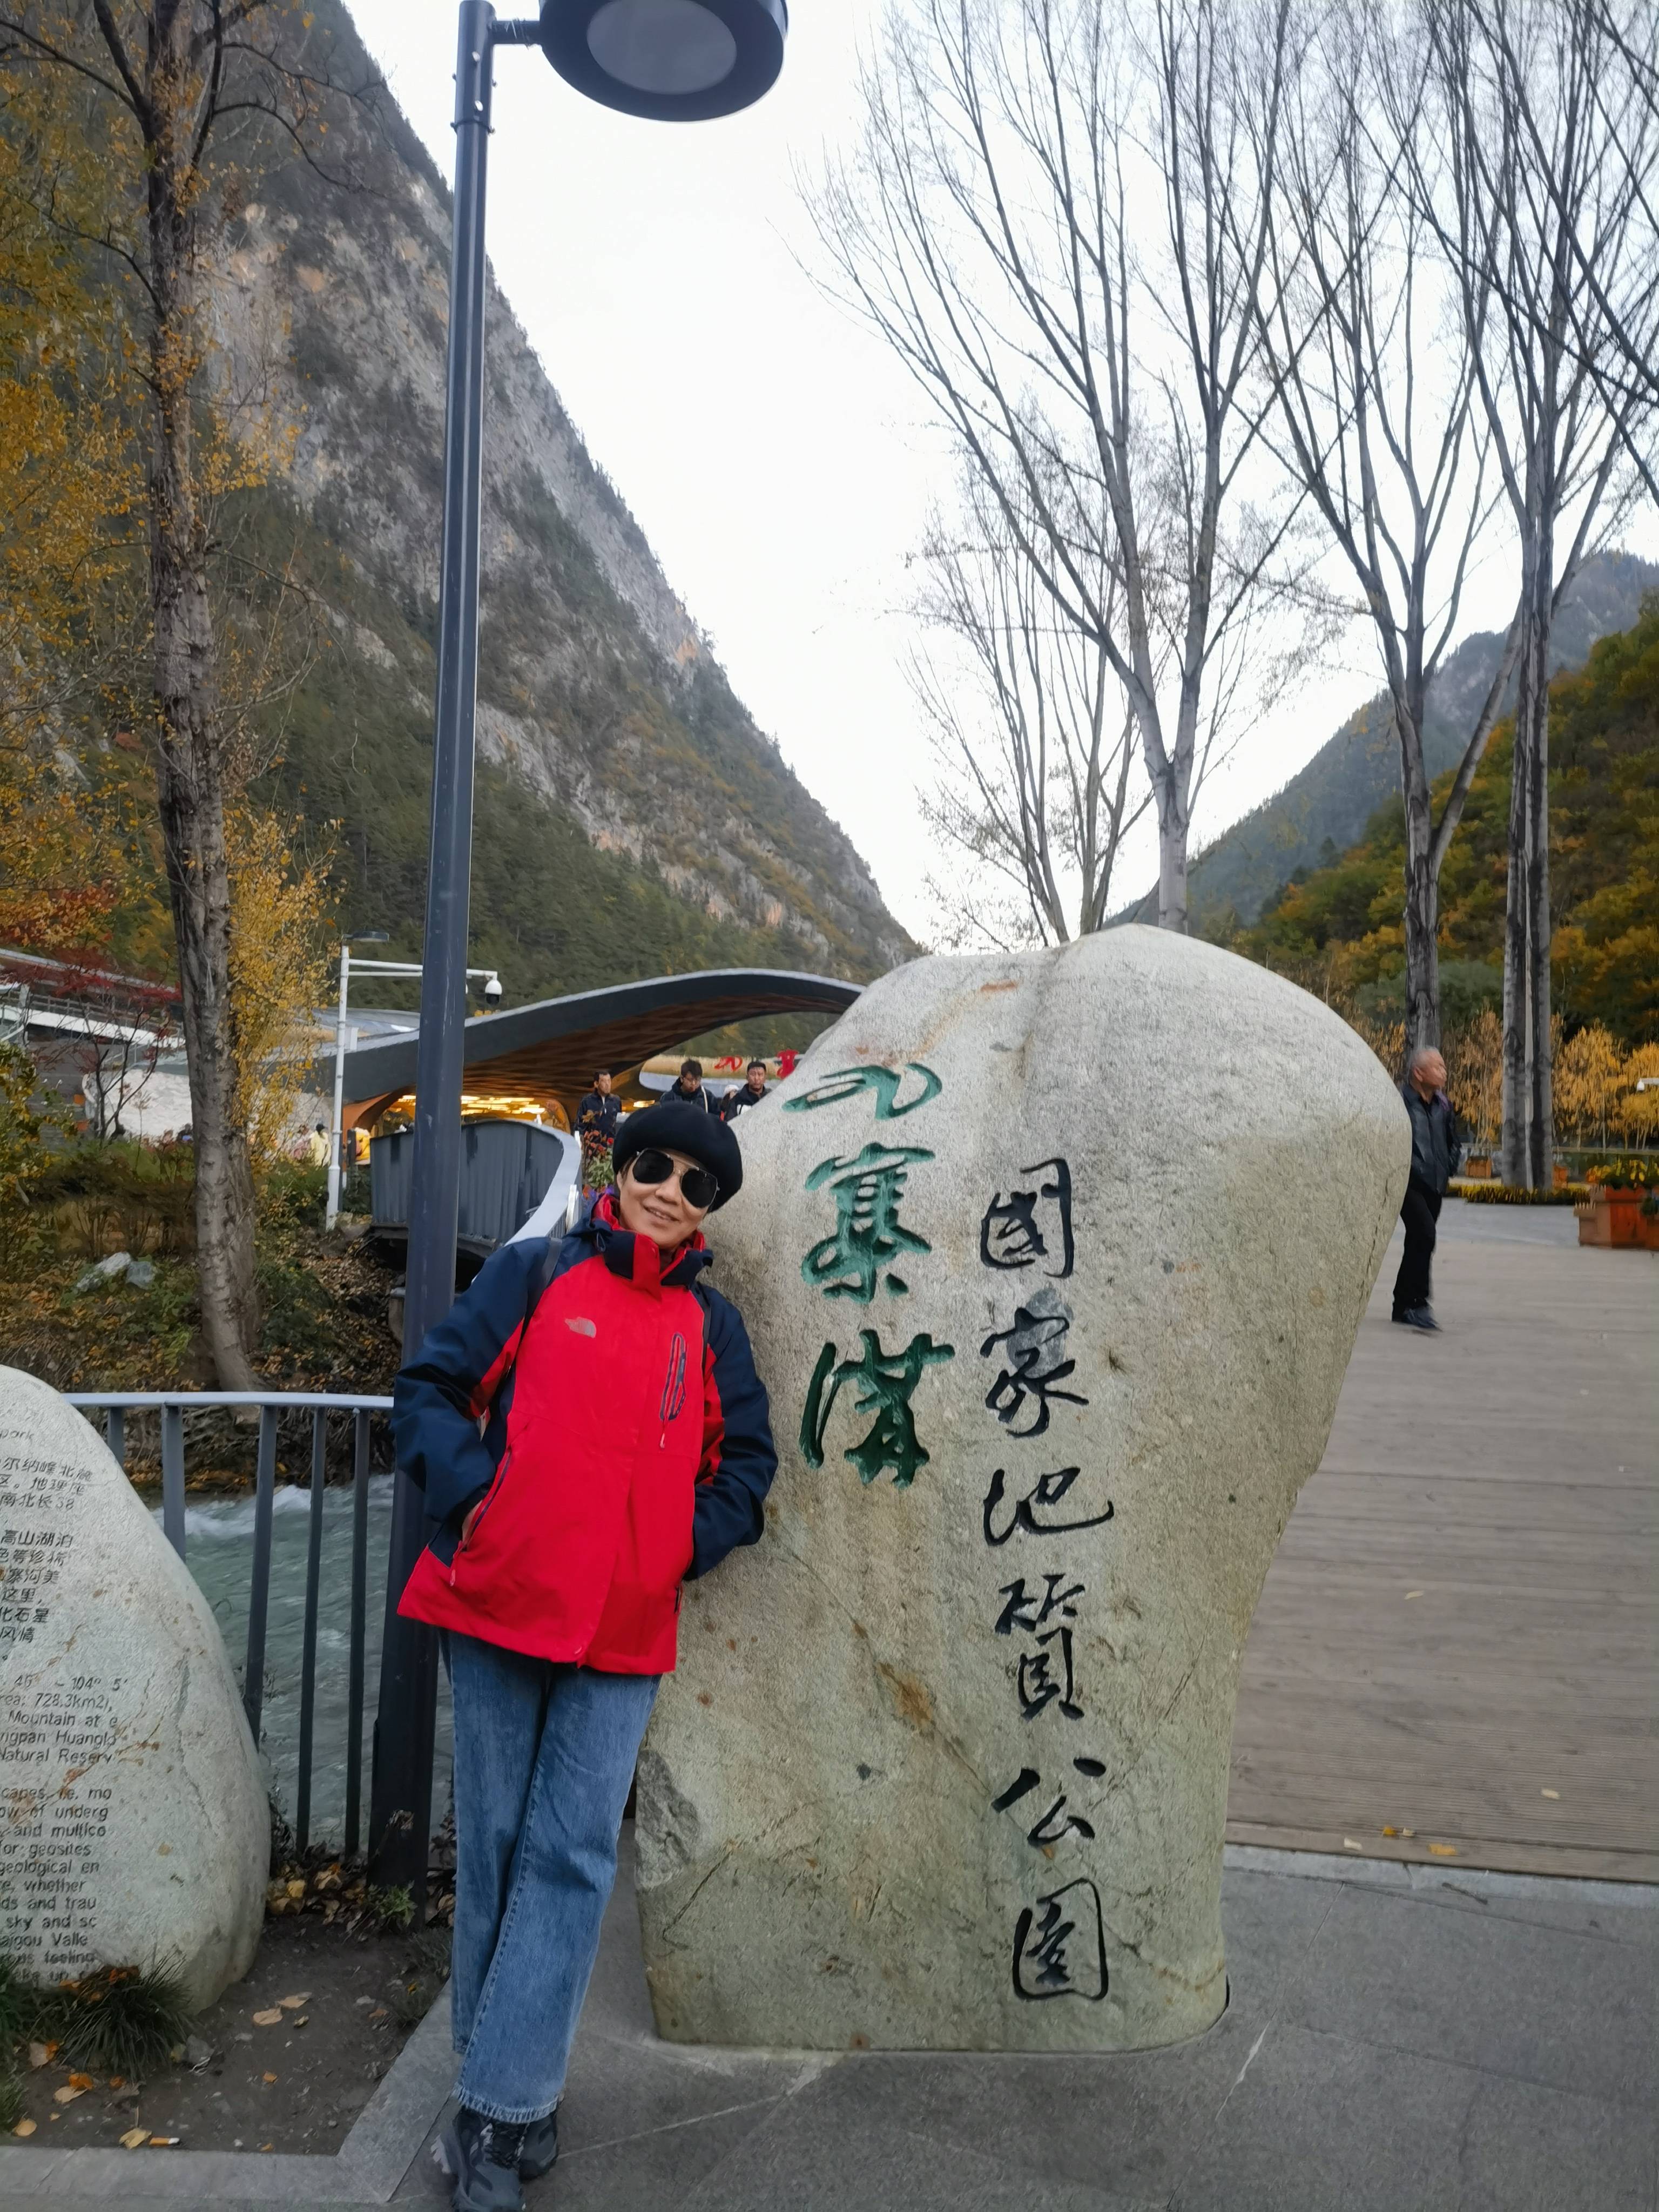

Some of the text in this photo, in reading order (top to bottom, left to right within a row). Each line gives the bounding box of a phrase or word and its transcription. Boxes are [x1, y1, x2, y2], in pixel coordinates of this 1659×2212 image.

[9, 1710, 76, 1727] Mountain
[85, 1714, 101, 1728] at
[82, 1862, 100, 1874] en
[27, 1895, 56, 1911] and
[42, 1915, 71, 1928] and
